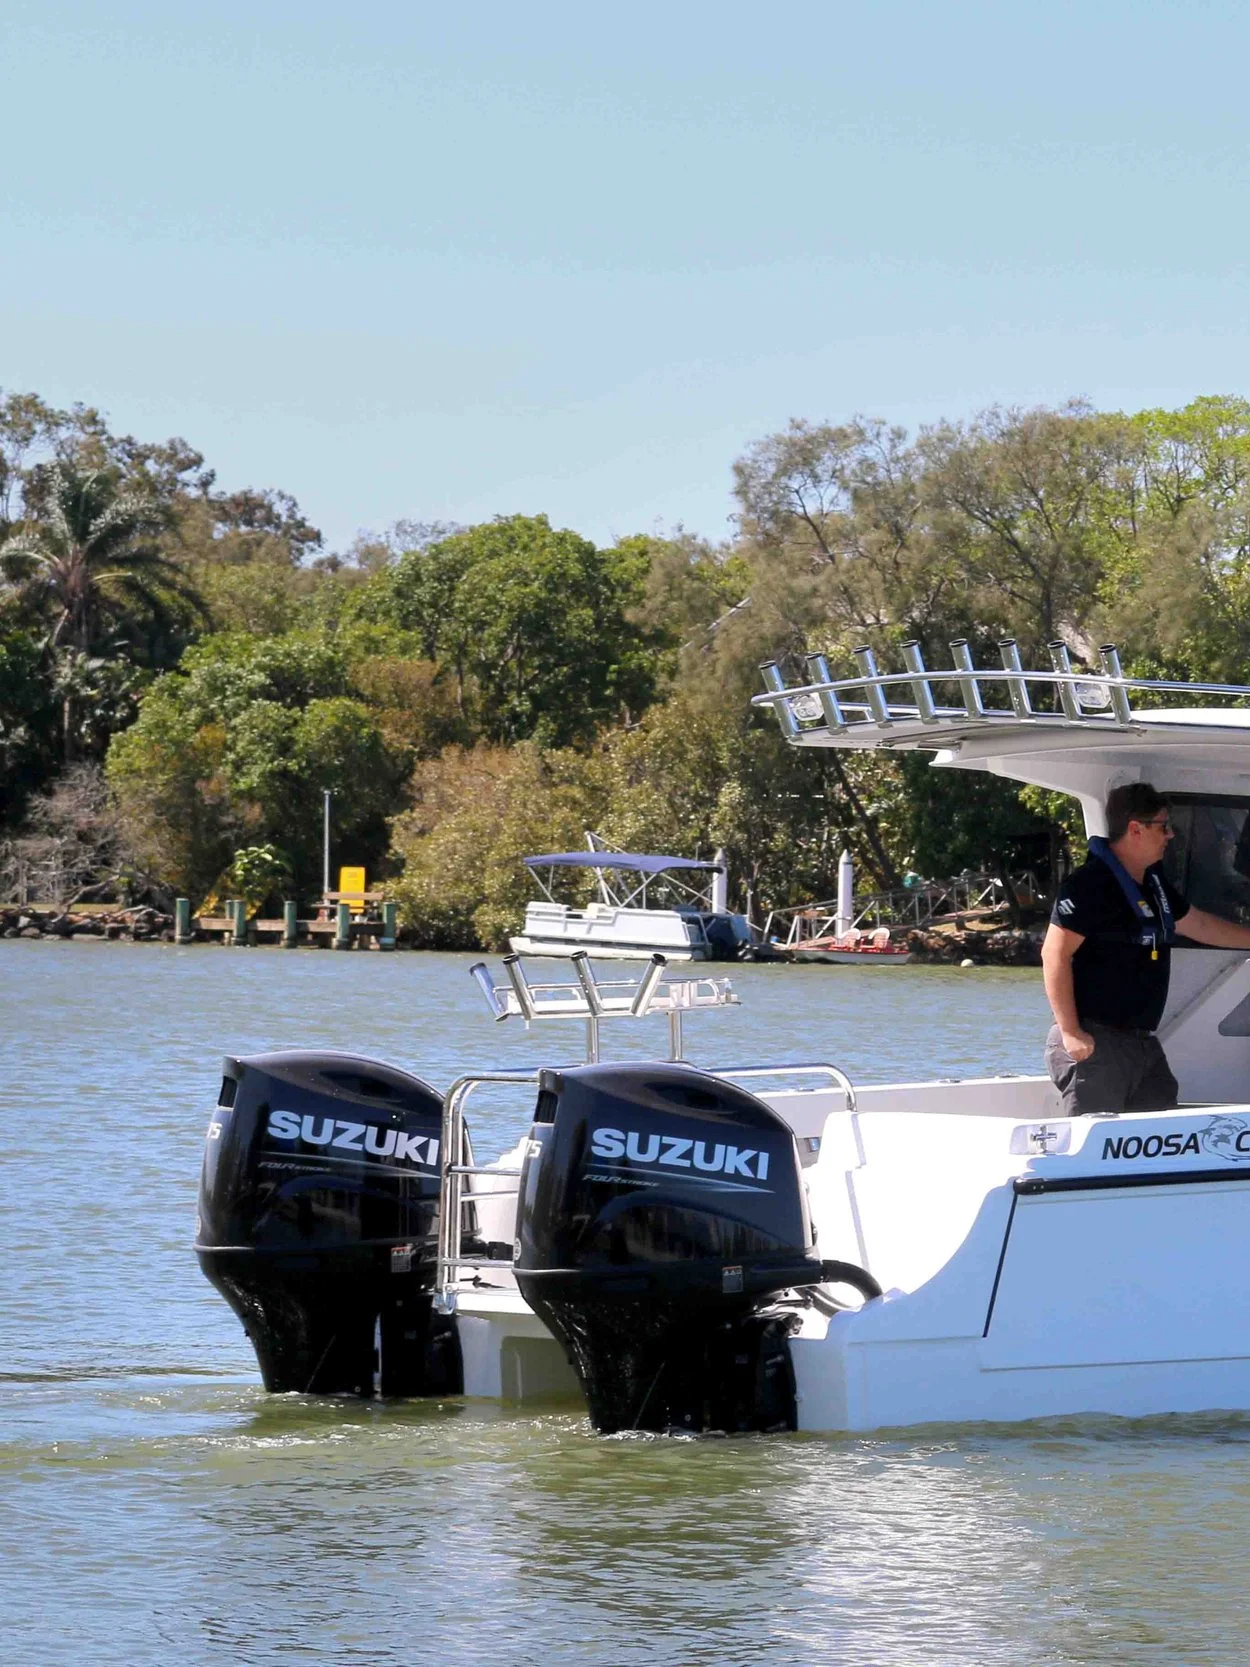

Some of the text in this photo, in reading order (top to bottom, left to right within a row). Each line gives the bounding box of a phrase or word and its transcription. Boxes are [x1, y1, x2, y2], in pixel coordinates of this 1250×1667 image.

[267, 1110, 440, 1166] SUZUKI
[591, 1127, 770, 1180] SUZUKI
[1102, 1132, 1200, 1160] NOOSA
